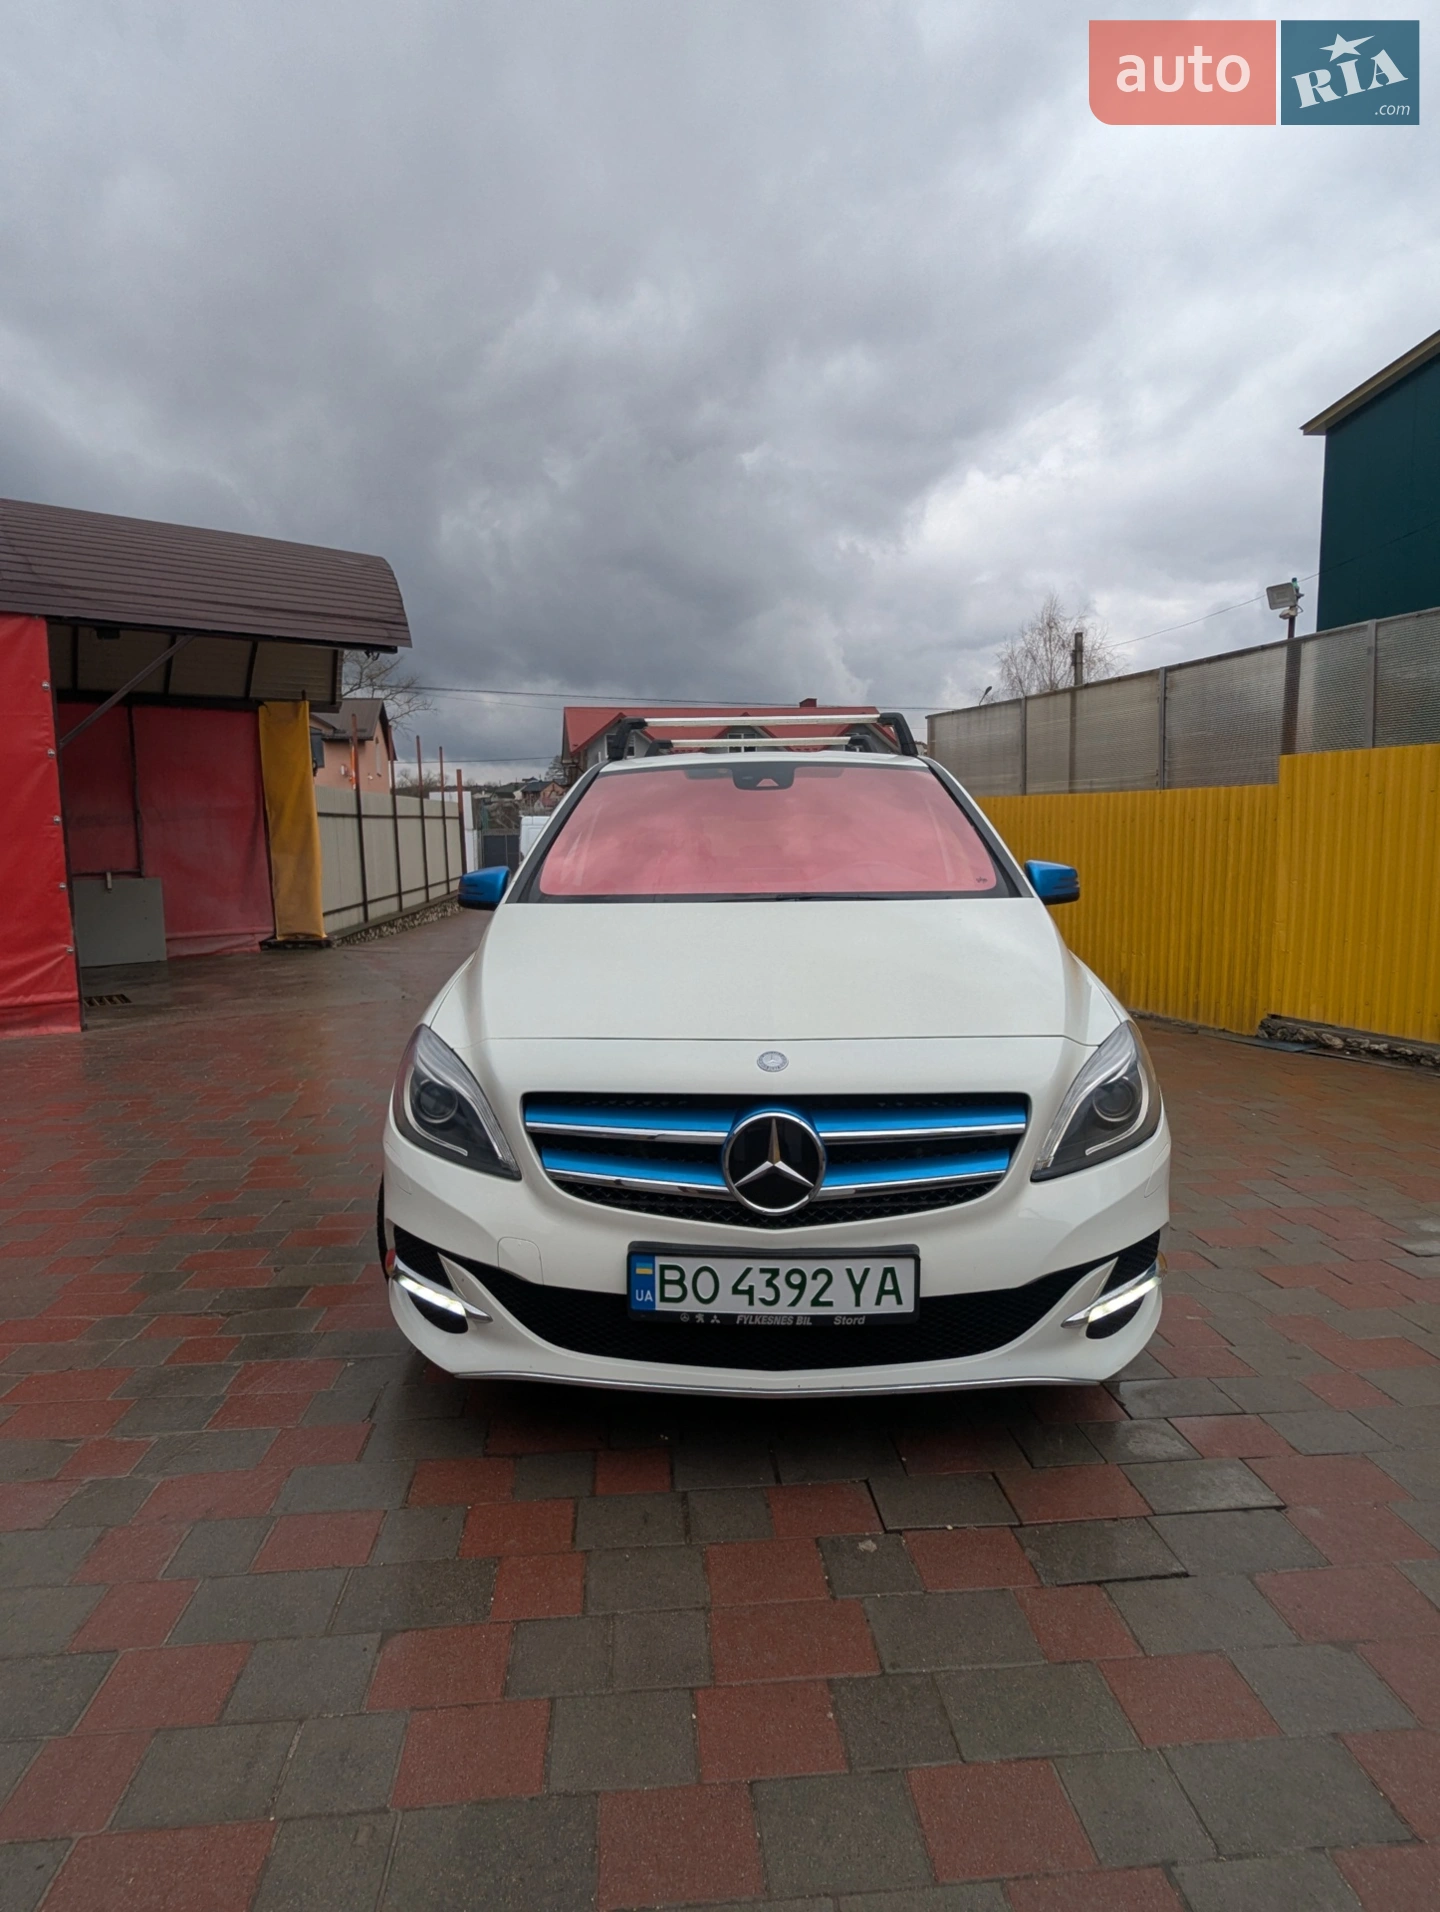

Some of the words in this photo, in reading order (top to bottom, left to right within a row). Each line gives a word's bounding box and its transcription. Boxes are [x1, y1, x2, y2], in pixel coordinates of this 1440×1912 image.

[658, 1263, 720, 1304] BO
[731, 1267, 834, 1307] 4392
[845, 1267, 904, 1306] YA
[635, 1289, 653, 1302] UA
[736, 1315, 794, 1326] FYLKESNES
[796, 1315, 813, 1326] BIL
[833, 1315, 866, 1326] Stord
